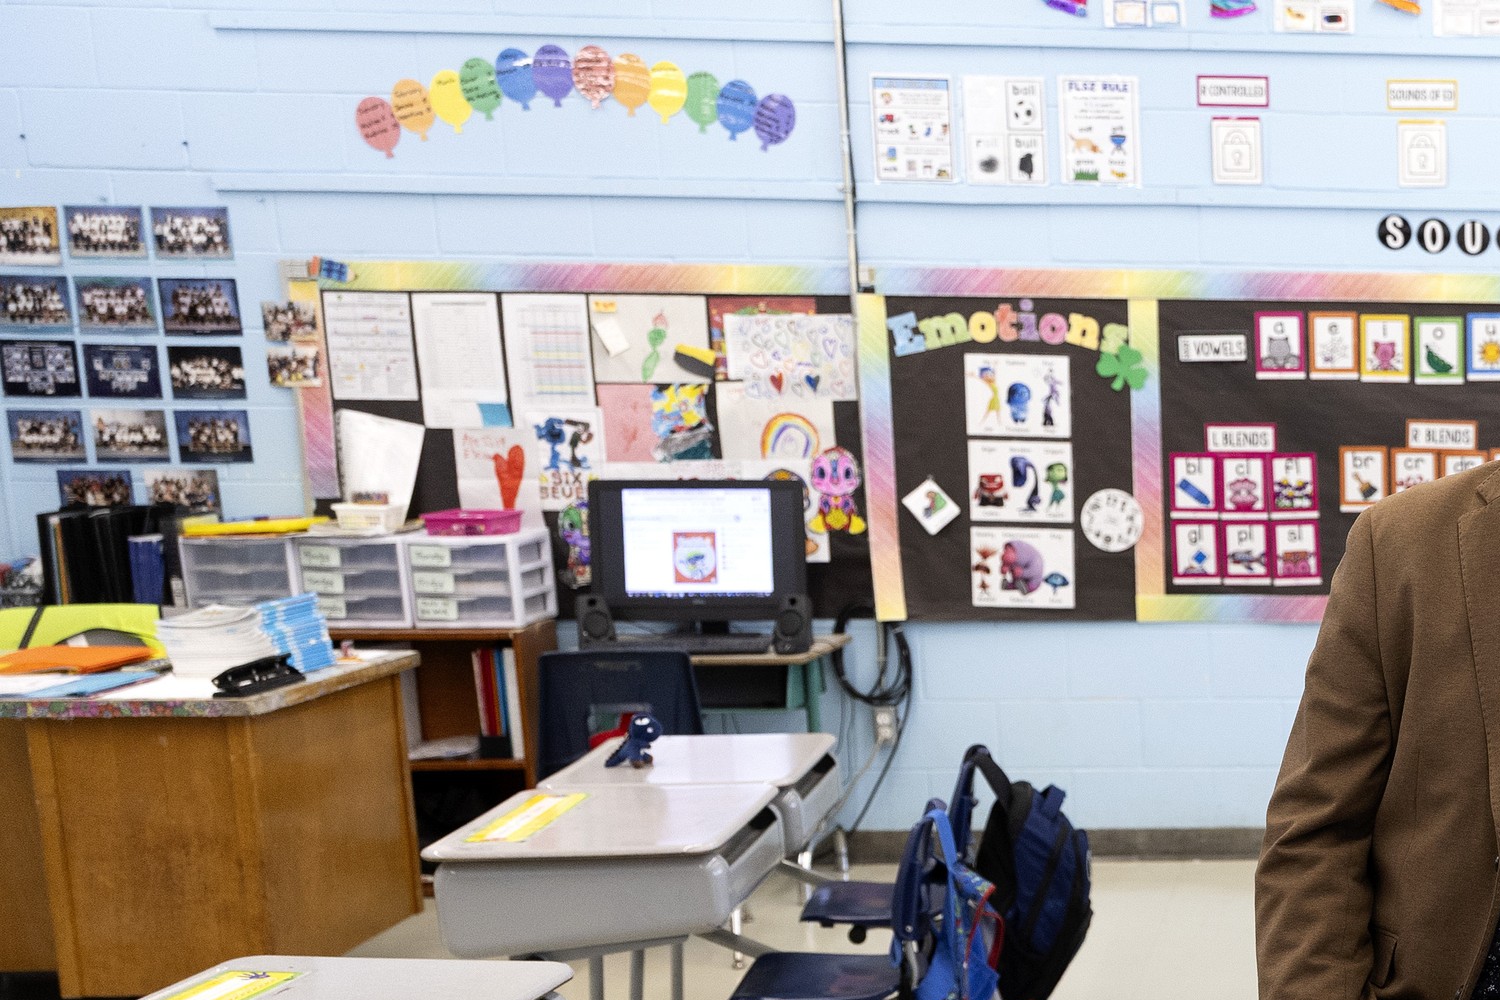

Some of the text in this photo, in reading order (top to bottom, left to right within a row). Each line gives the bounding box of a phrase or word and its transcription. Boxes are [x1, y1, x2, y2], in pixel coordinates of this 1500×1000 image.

[1209, 85, 1263, 97] CONTROLLED
[1389, 88, 1427, 101] SOUNDS
[886, 298, 1130, 357] Emotions
[1273, 322, 1286, 335] a
[1328, 323, 1340, 336] e
[1432, 328, 1446, 340] o
[1193, 340, 1243, 358] VOWELS
[1222, 431, 1268, 447] BLENDS
[1425, 428, 1470, 444] BLENDS
[1185, 457, 1203, 475] bl
[1235, 459, 1250, 476] cl
[1285, 457, 1300, 474] fl
[1352, 453, 1374, 469] br
[1404, 457, 1422, 471] cr
[1189, 530, 1203, 547] gl
[1238, 528, 1252, 545] pl
[1288, 526, 1303, 542] sl
